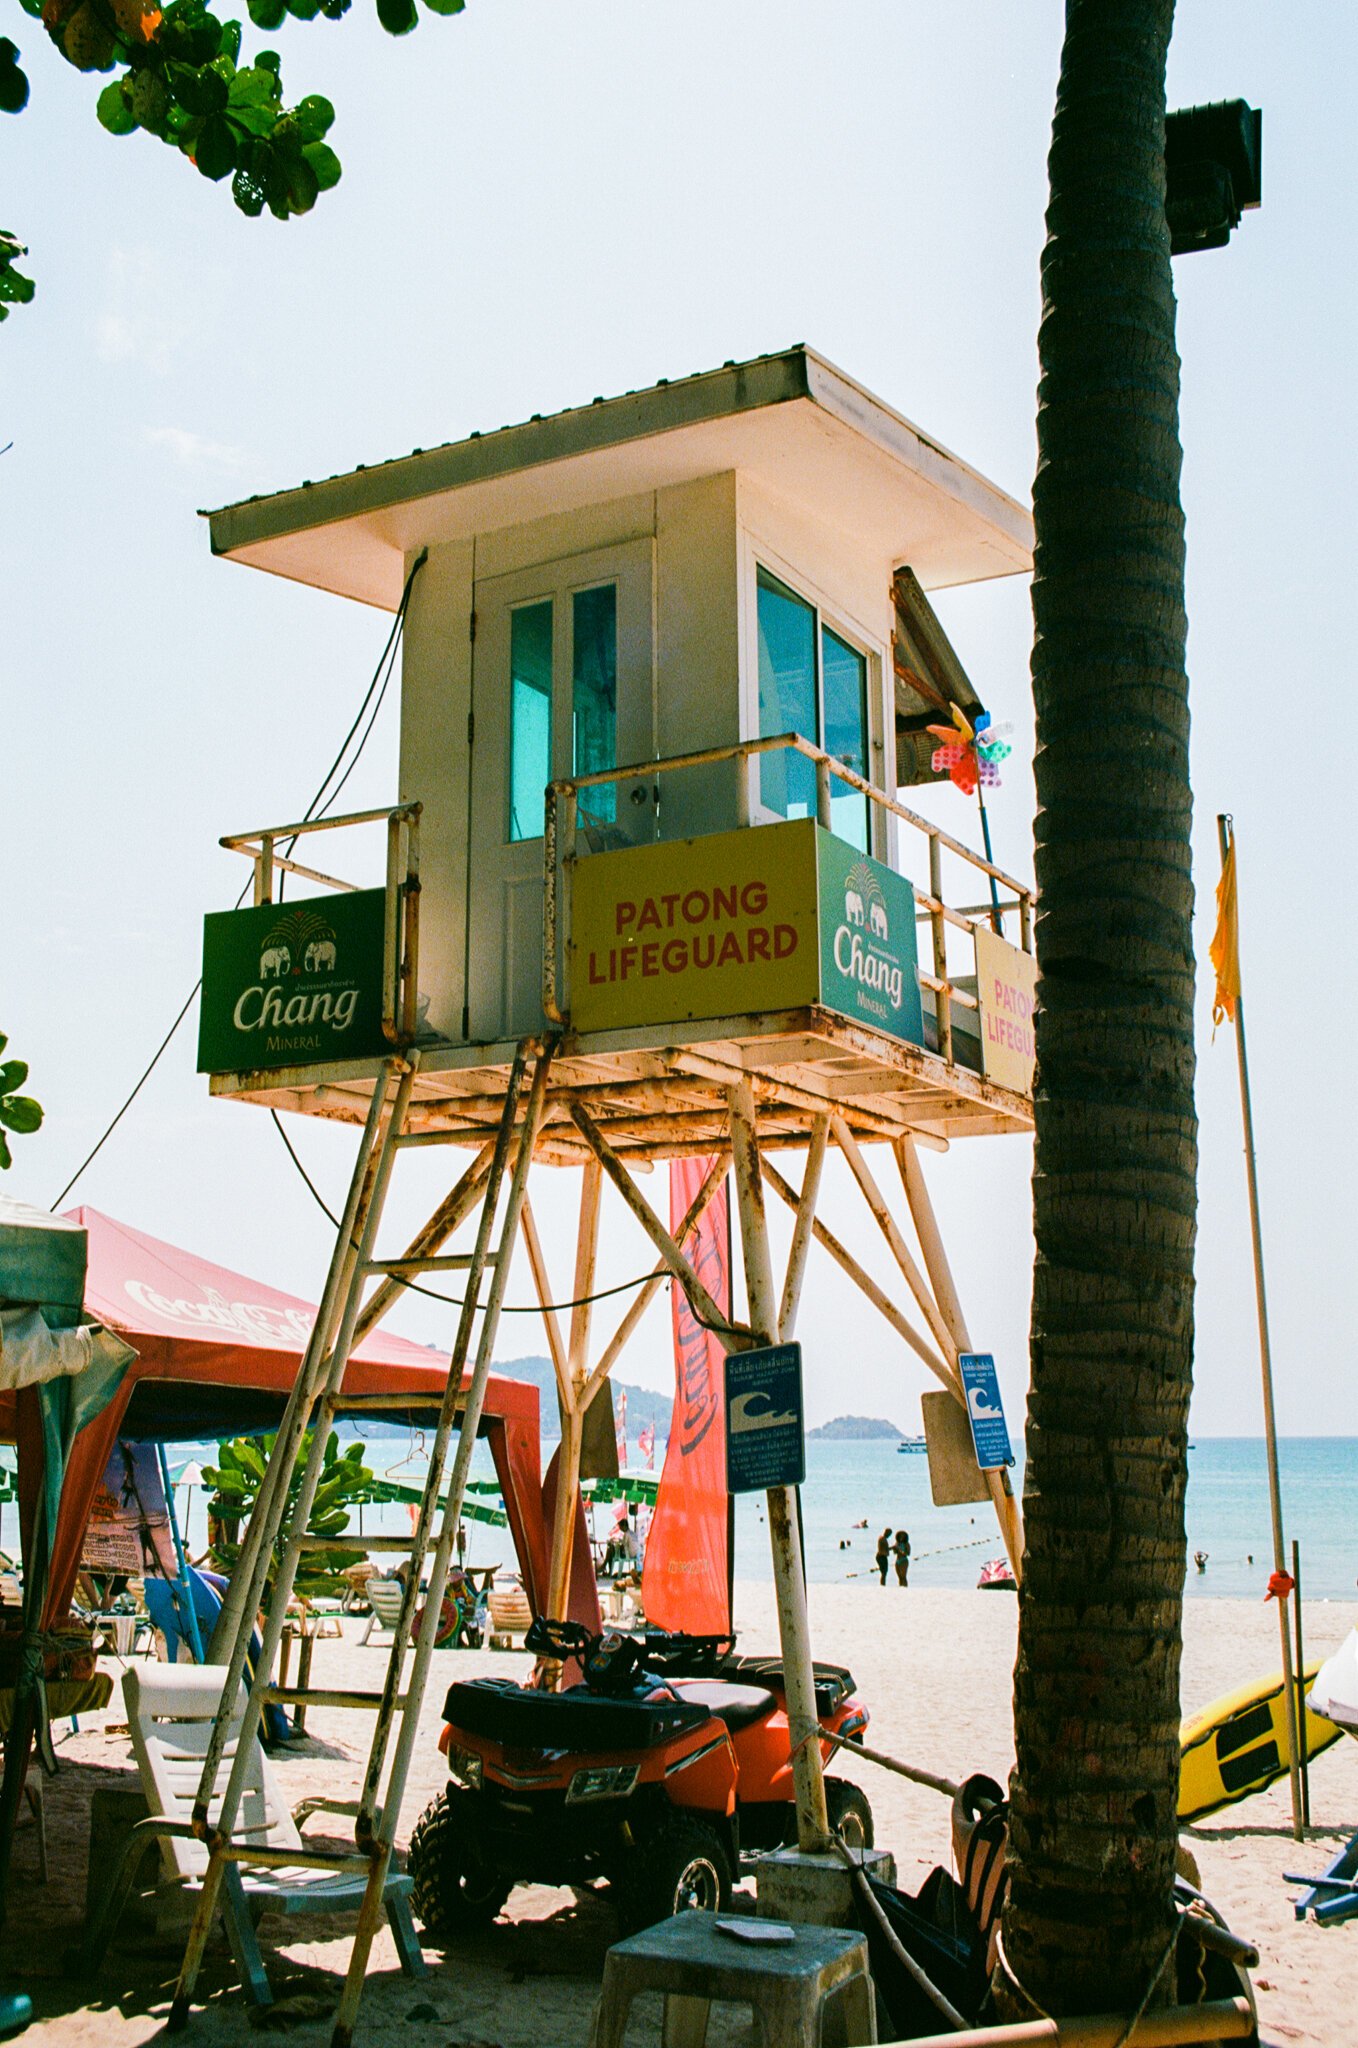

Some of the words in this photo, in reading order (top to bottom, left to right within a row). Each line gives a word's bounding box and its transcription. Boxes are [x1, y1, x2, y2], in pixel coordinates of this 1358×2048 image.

[615, 881, 769, 936] PATONG
[588, 923, 799, 985] LIFEGUARD
[834, 924, 903, 1010] Chang
[233, 985, 360, 1032] Chang
[857, 989, 888, 1020] MINERAL
[265, 1034, 322, 1052] MINERAL
